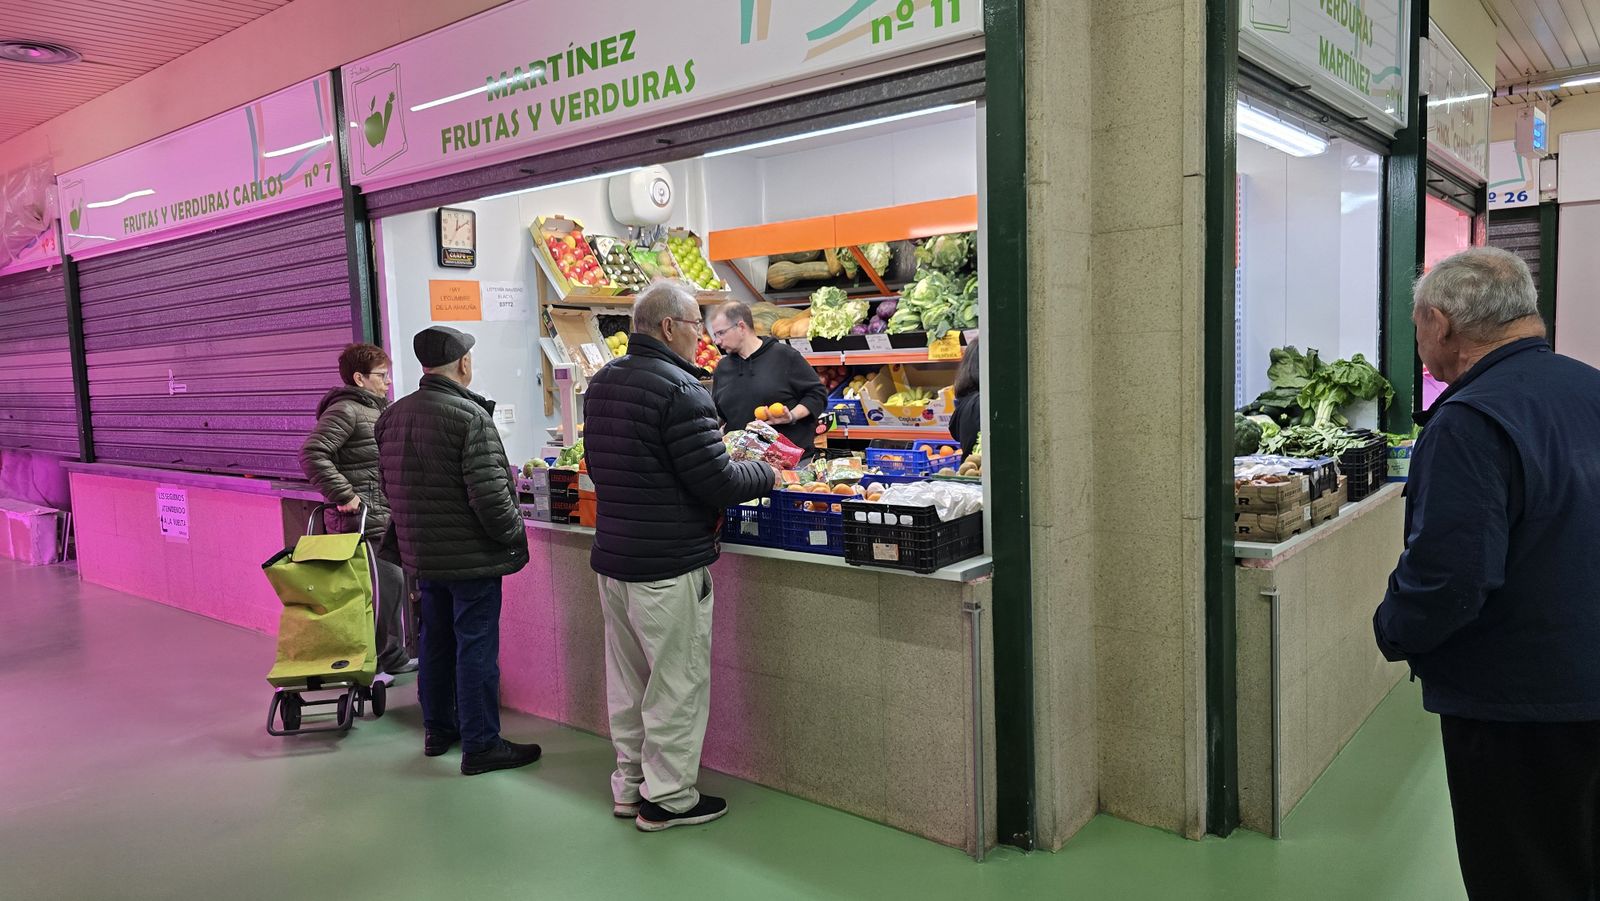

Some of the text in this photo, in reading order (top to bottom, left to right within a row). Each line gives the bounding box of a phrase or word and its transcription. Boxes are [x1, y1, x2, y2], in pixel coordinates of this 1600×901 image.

[872, 0, 961, 44] nº 11
[486, 30, 637, 102] MARTÍNEZ
[1319, 35, 1371, 96] MARTÍNEZ
[441, 58, 696, 153] FRUTAS Y VERDURAS
[124, 208, 159, 234] FRUTAS
[161, 206, 169, 225] Y
[171, 188, 230, 222] VERDURAS
[233, 172, 284, 206] CARLOS
[324, 162, 332, 183] 7
[1488, 190, 1528, 204] º 26
